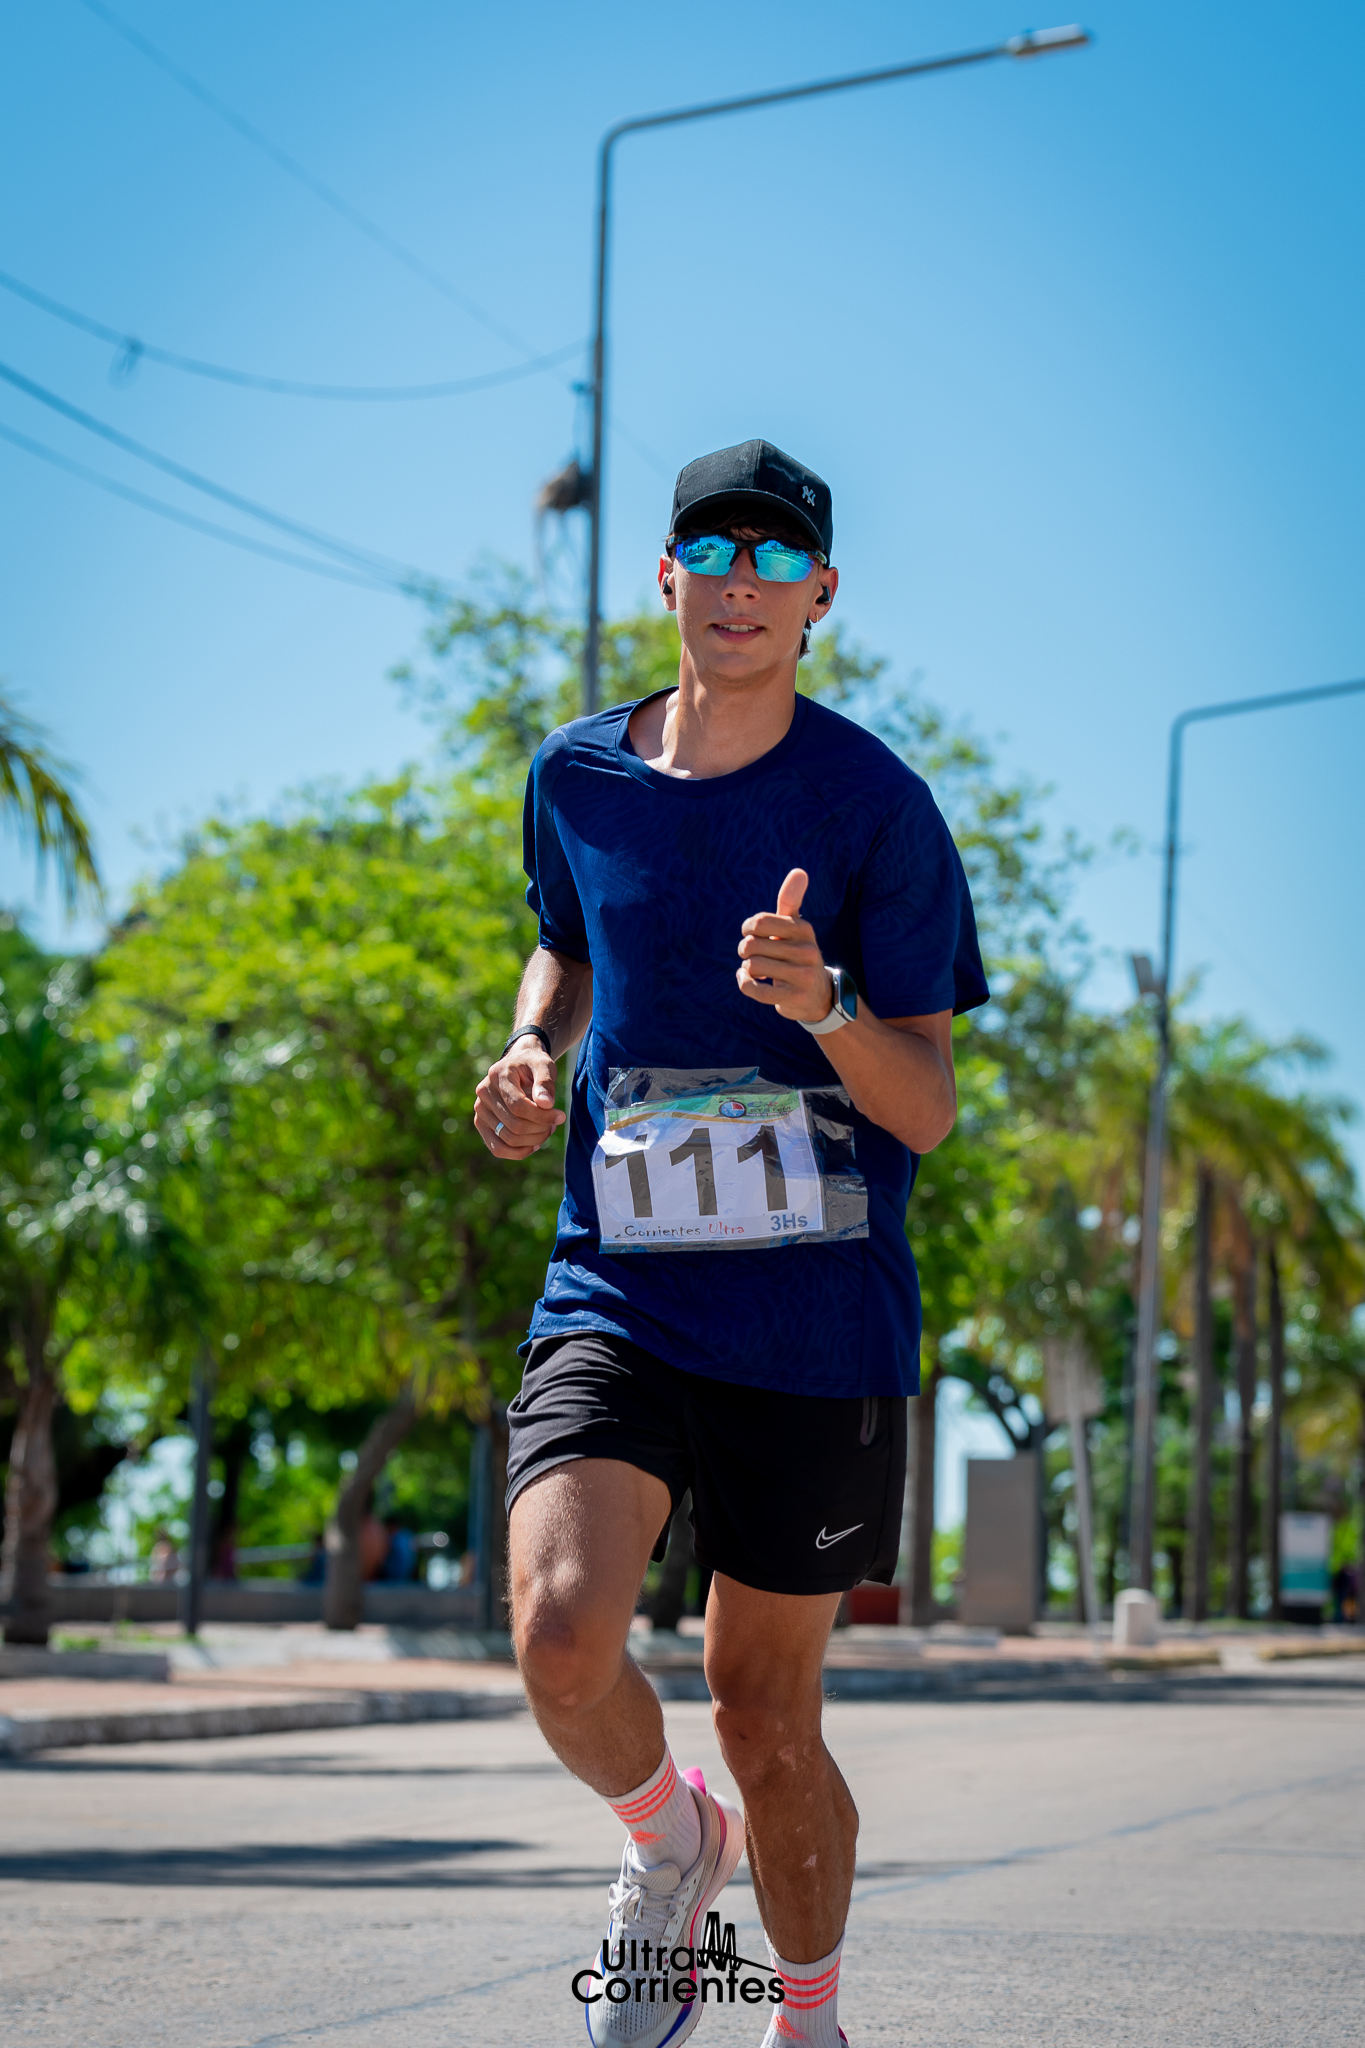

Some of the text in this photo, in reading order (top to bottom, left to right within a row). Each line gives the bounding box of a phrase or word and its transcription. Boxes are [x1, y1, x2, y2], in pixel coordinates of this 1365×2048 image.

[802, 486, 816, 507] NY
[605, 1125, 788, 1218] 111
[624, 1222, 745, 1238] Corrientes Ultra
[770, 1213, 808, 1232] 3Hs
